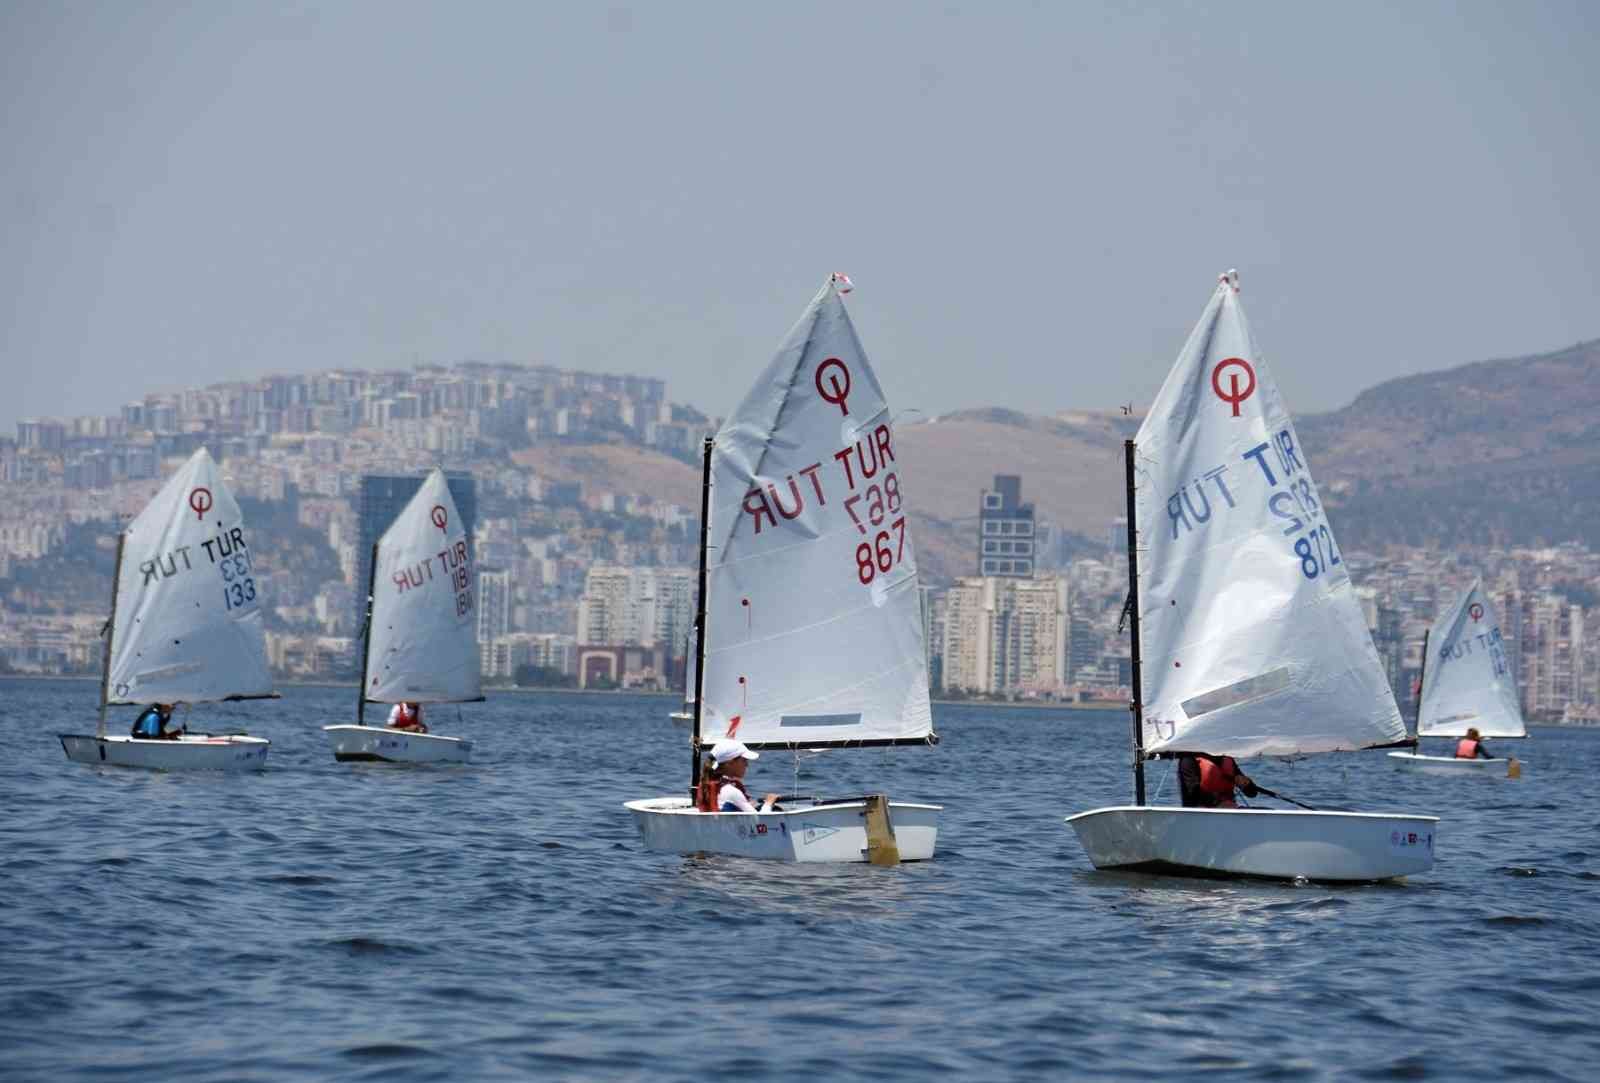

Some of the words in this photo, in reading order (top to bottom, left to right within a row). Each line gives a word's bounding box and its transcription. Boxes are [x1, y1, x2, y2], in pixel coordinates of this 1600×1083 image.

[834, 424, 895, 490] TUR
[1242, 429, 1303, 487] TUR
[201, 527, 246, 563] TUR
[438, 541, 468, 575] TUR
[856, 516, 905, 585] 867
[1294, 523, 1340, 580] 872
[224, 578, 257, 611] 133
